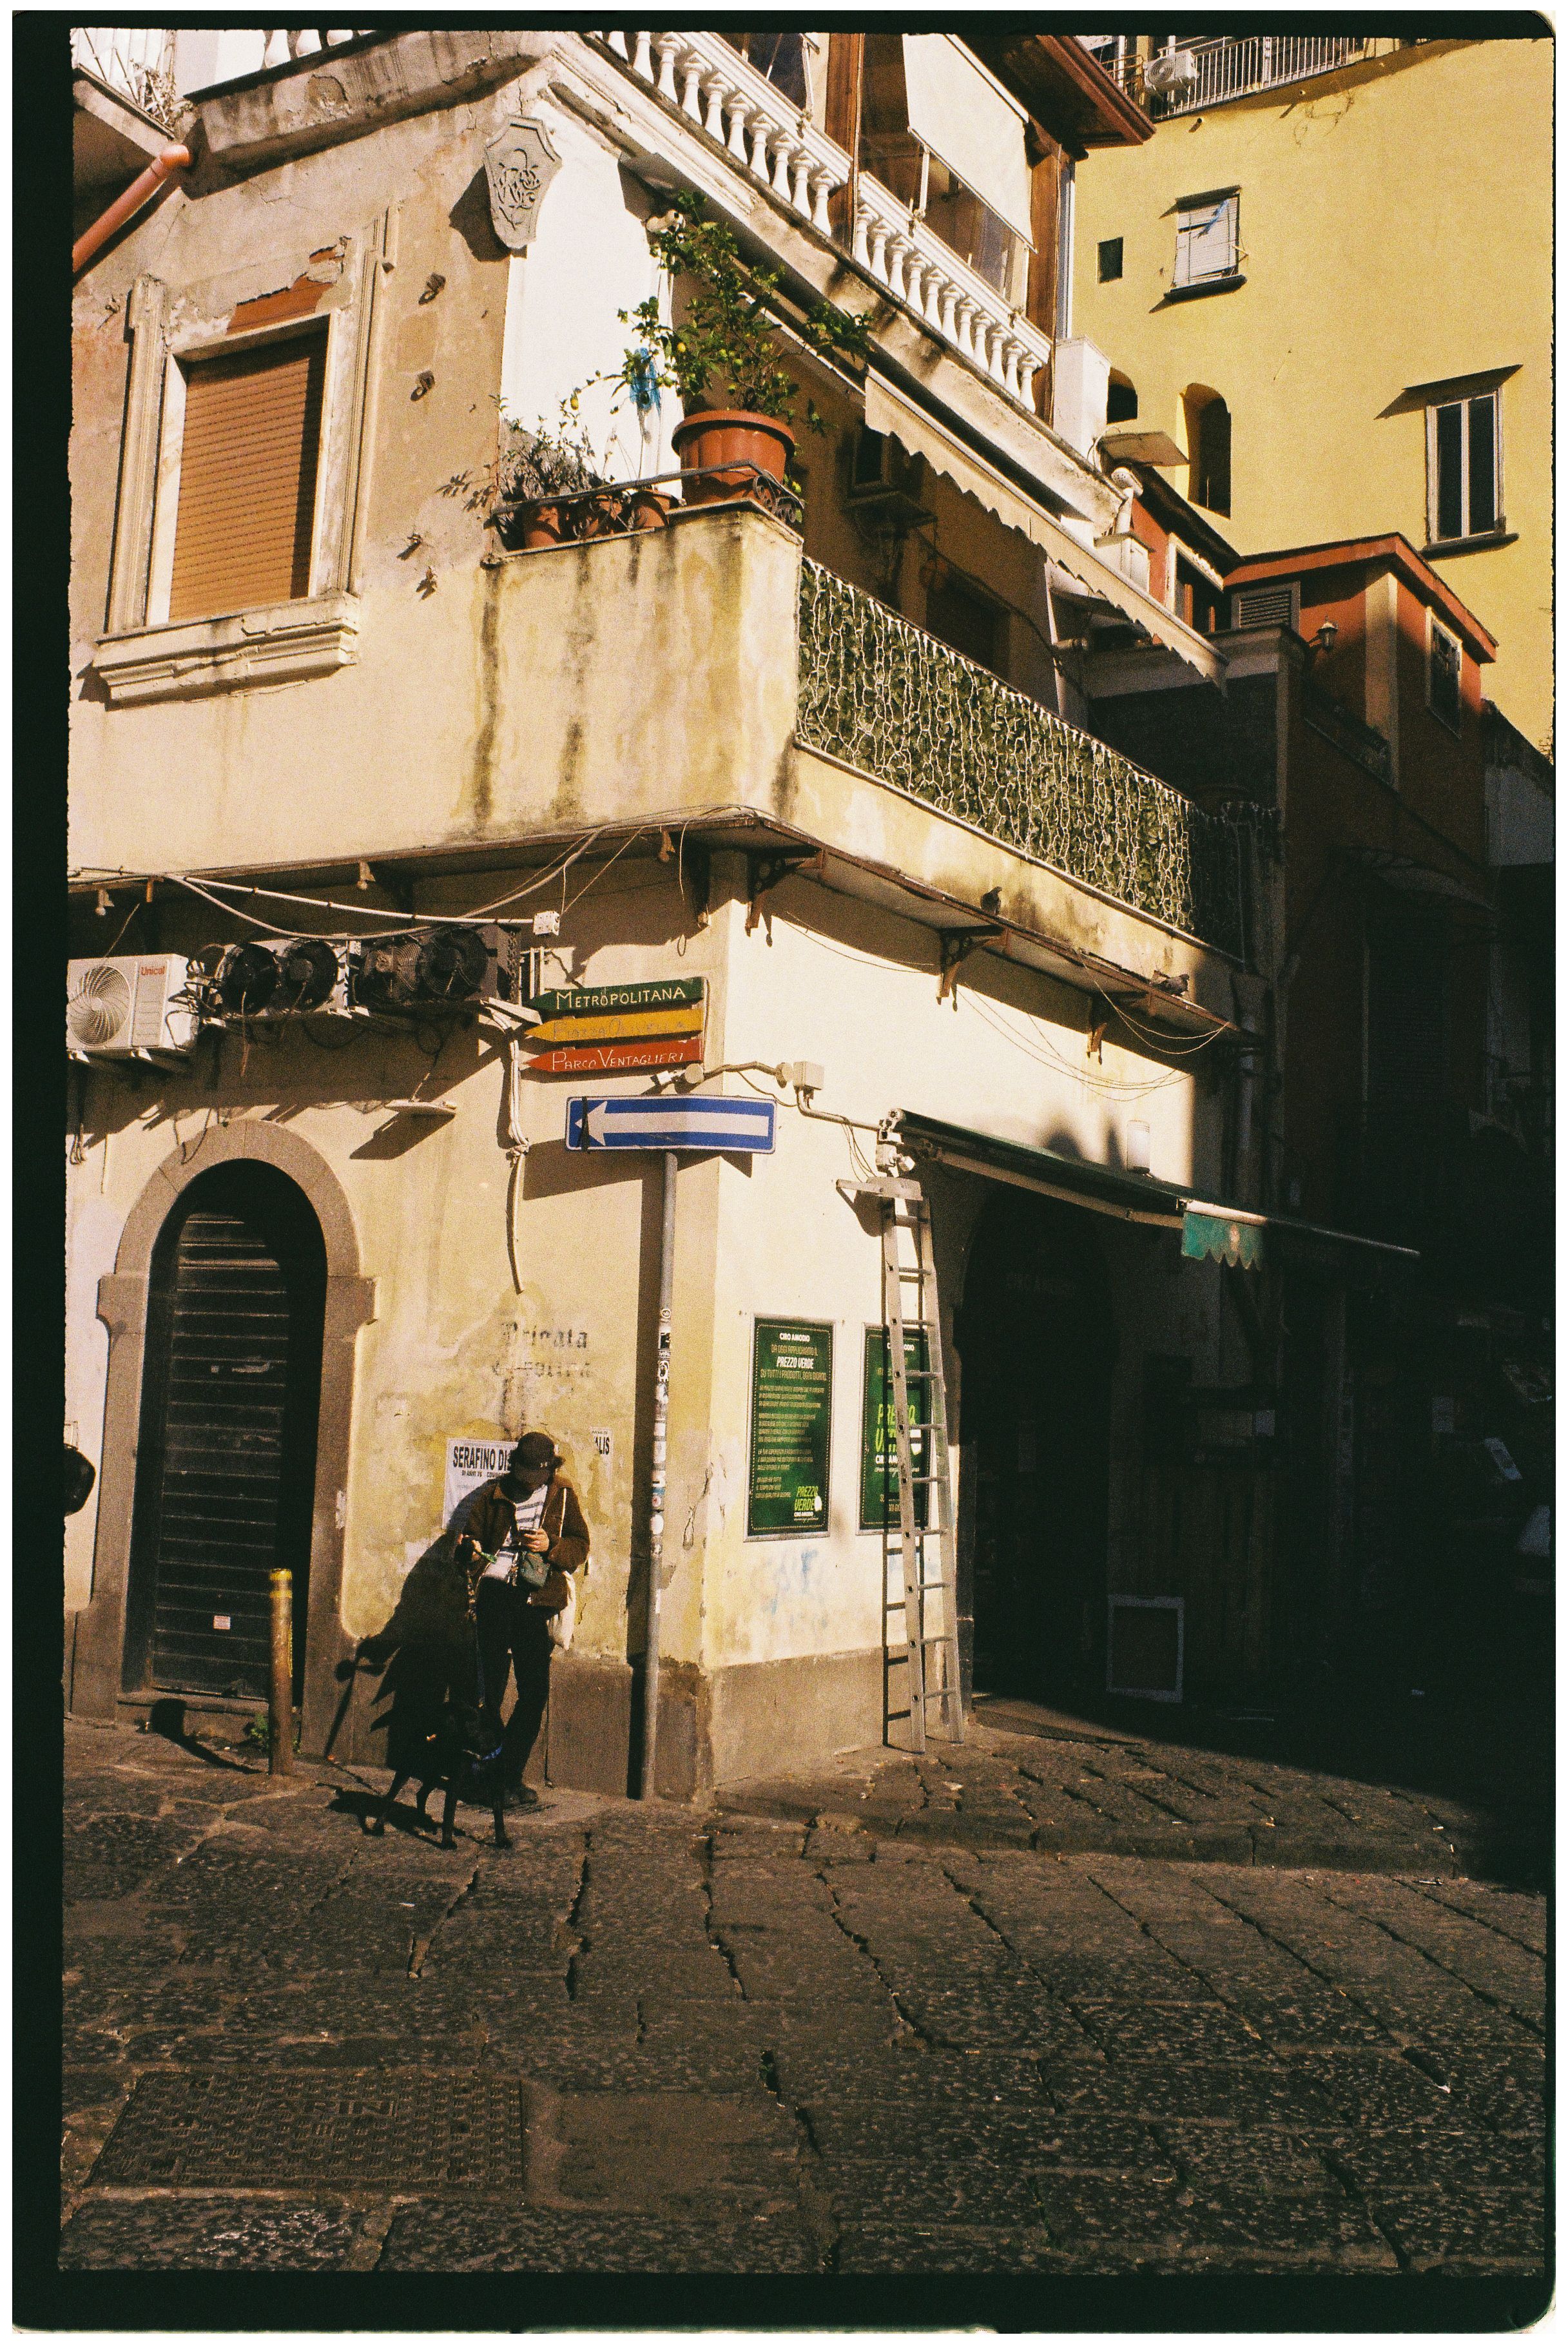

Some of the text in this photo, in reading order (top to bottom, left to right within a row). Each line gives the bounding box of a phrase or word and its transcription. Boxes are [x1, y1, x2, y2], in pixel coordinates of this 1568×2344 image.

[140, 965, 166, 976] Unical
[556, 987, 686, 1009] METROPOLITANA
[552, 1049, 684, 1071] PARCO VENTAGLIERI
[777, 1356, 814, 1369] PREZZO VERDE
[453, 1446, 496, 1470] SERAFINO
[797, 1486, 818, 1497] PREZZO
[794, 1498, 815, 1511] VERDE
